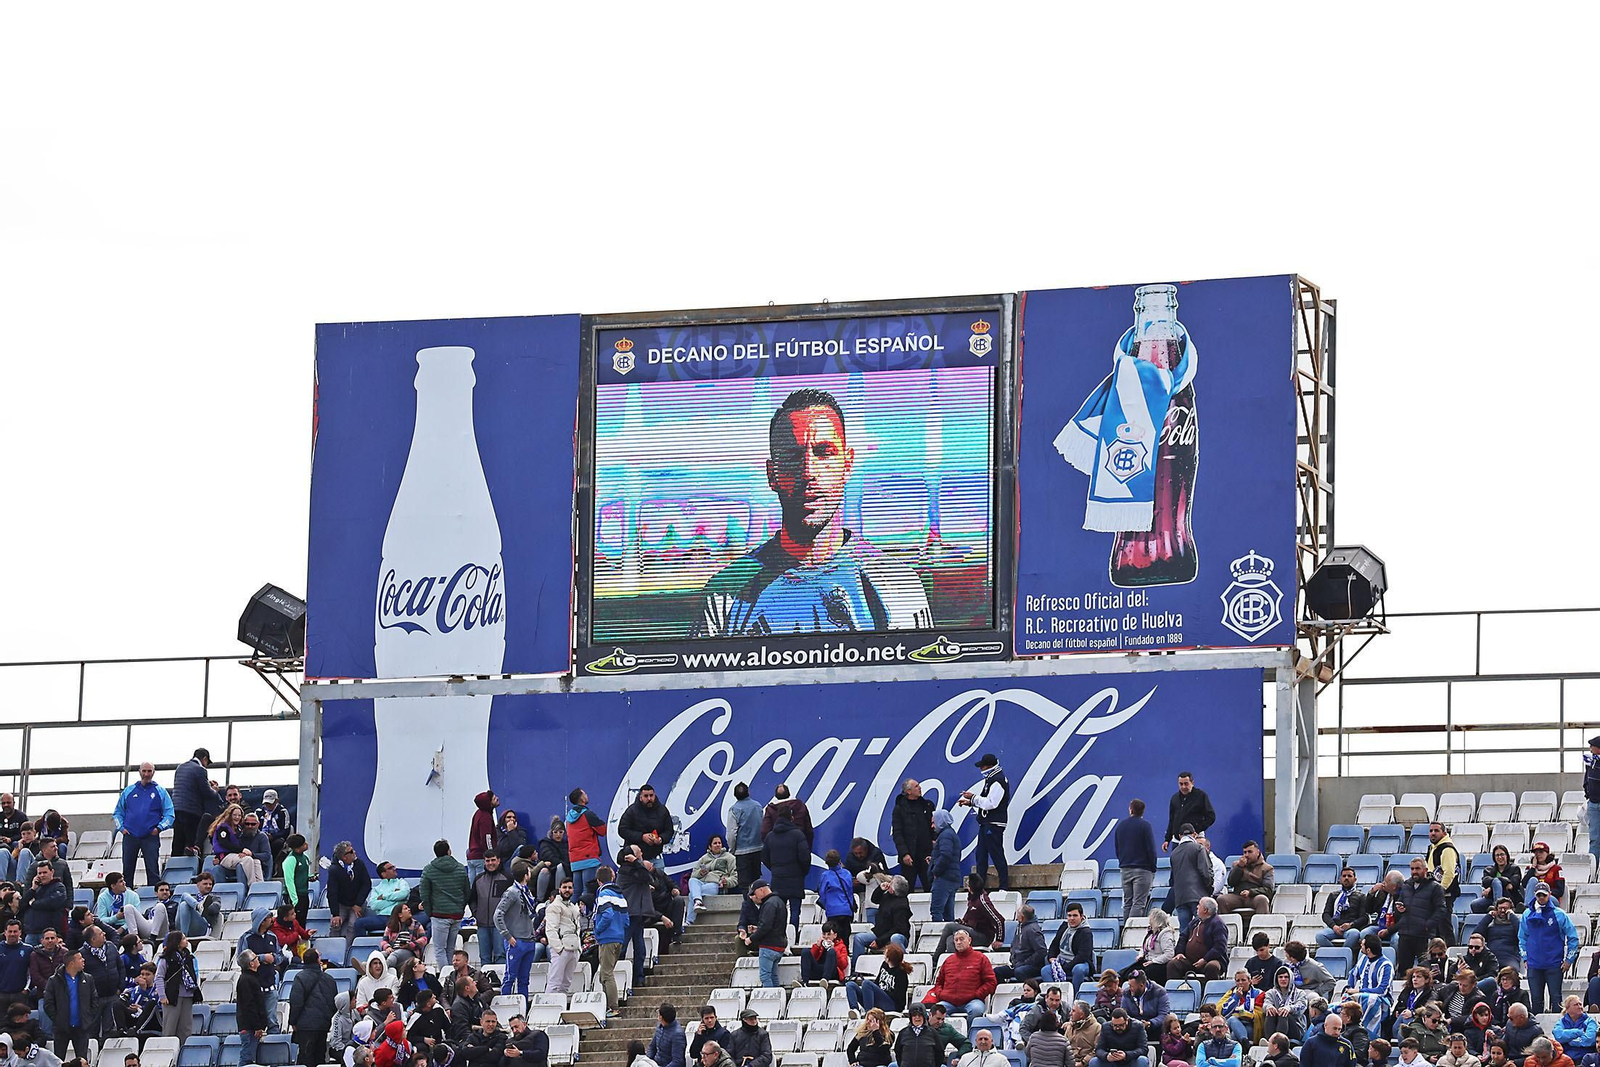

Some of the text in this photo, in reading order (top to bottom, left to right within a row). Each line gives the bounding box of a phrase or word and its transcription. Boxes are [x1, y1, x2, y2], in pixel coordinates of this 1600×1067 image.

[648, 345, 728, 364] DECANO
[733, 343, 770, 361] DEL
[775, 337, 850, 358] FÚTBOL
[855, 333, 944, 355] ESPAÑOL
[378, 562, 503, 636] Coca-Cola
[1026, 589, 1149, 612] Refresco Oficial del:
[1026, 611, 1183, 634] R.C. Recreativo de Huelva
[1026, 633, 1183, 650] Decano del fútbol español Fundado en 1889
[682, 643, 906, 668] www.alosonido.net
